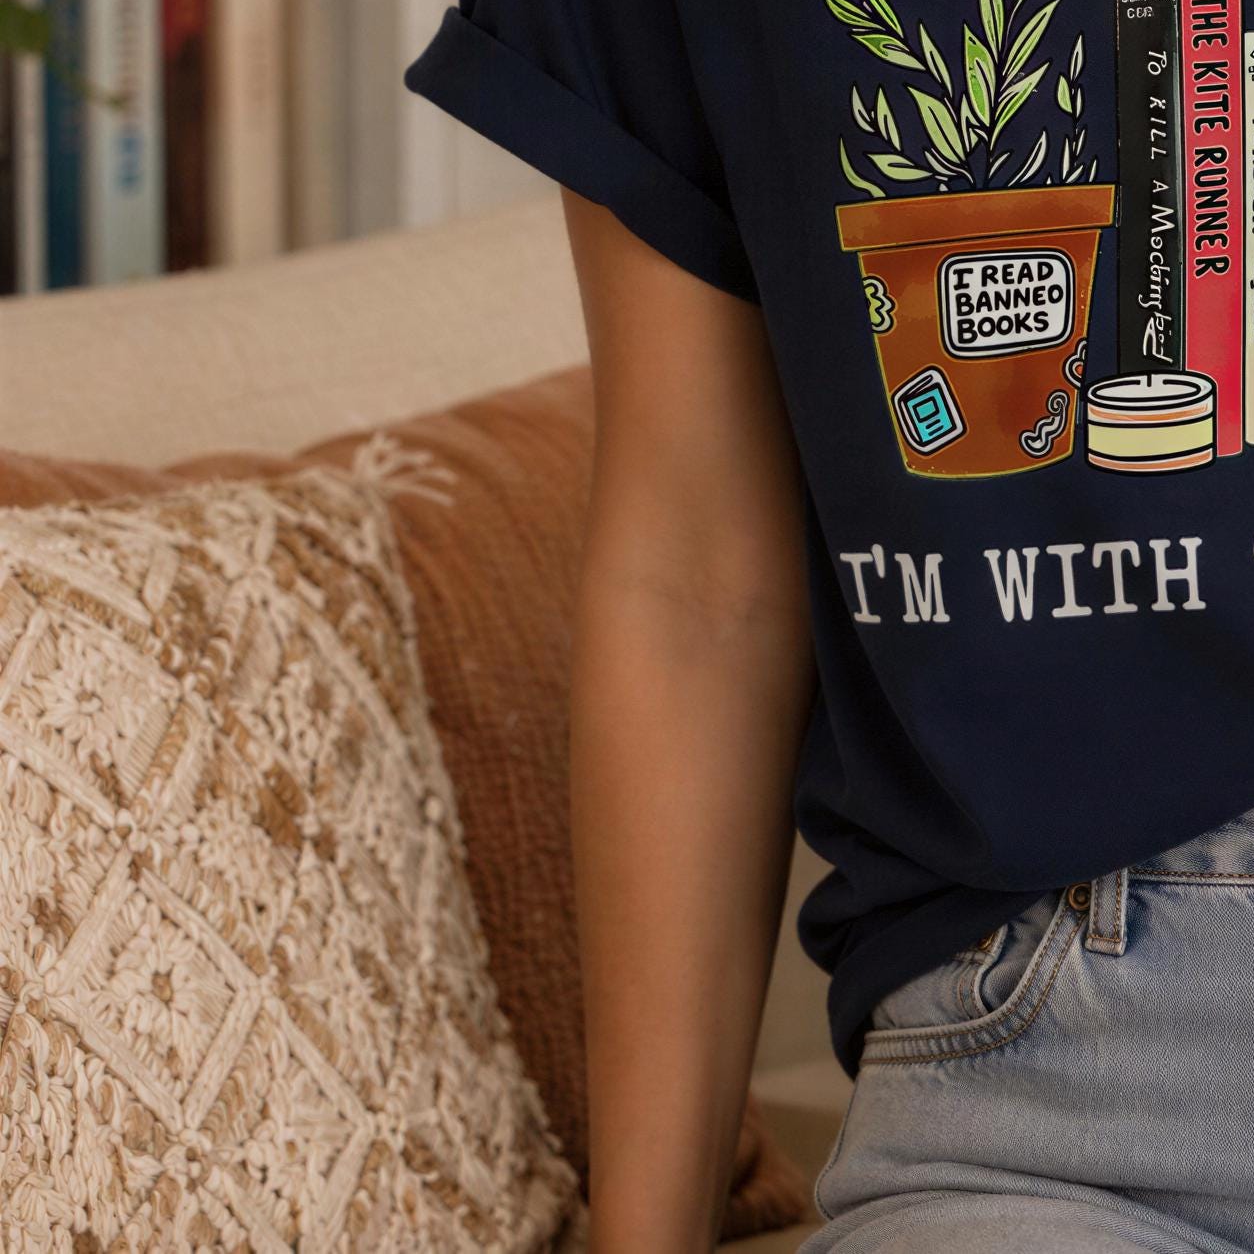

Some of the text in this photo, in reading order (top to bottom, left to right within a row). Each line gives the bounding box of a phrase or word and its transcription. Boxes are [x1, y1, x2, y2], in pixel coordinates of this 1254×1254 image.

[1150, 96, 1167, 160] KILL
[1193, 61, 1230, 134] KITE
[1153, 180, 1169, 193] A
[1194, 146, 1231, 278] RUNNER
[952, 261, 1054, 290] I READ
[957, 311, 1050, 345] BOOKS
[839, 545, 950, 624] I'M
[984, 537, 1207, 623] WITH
